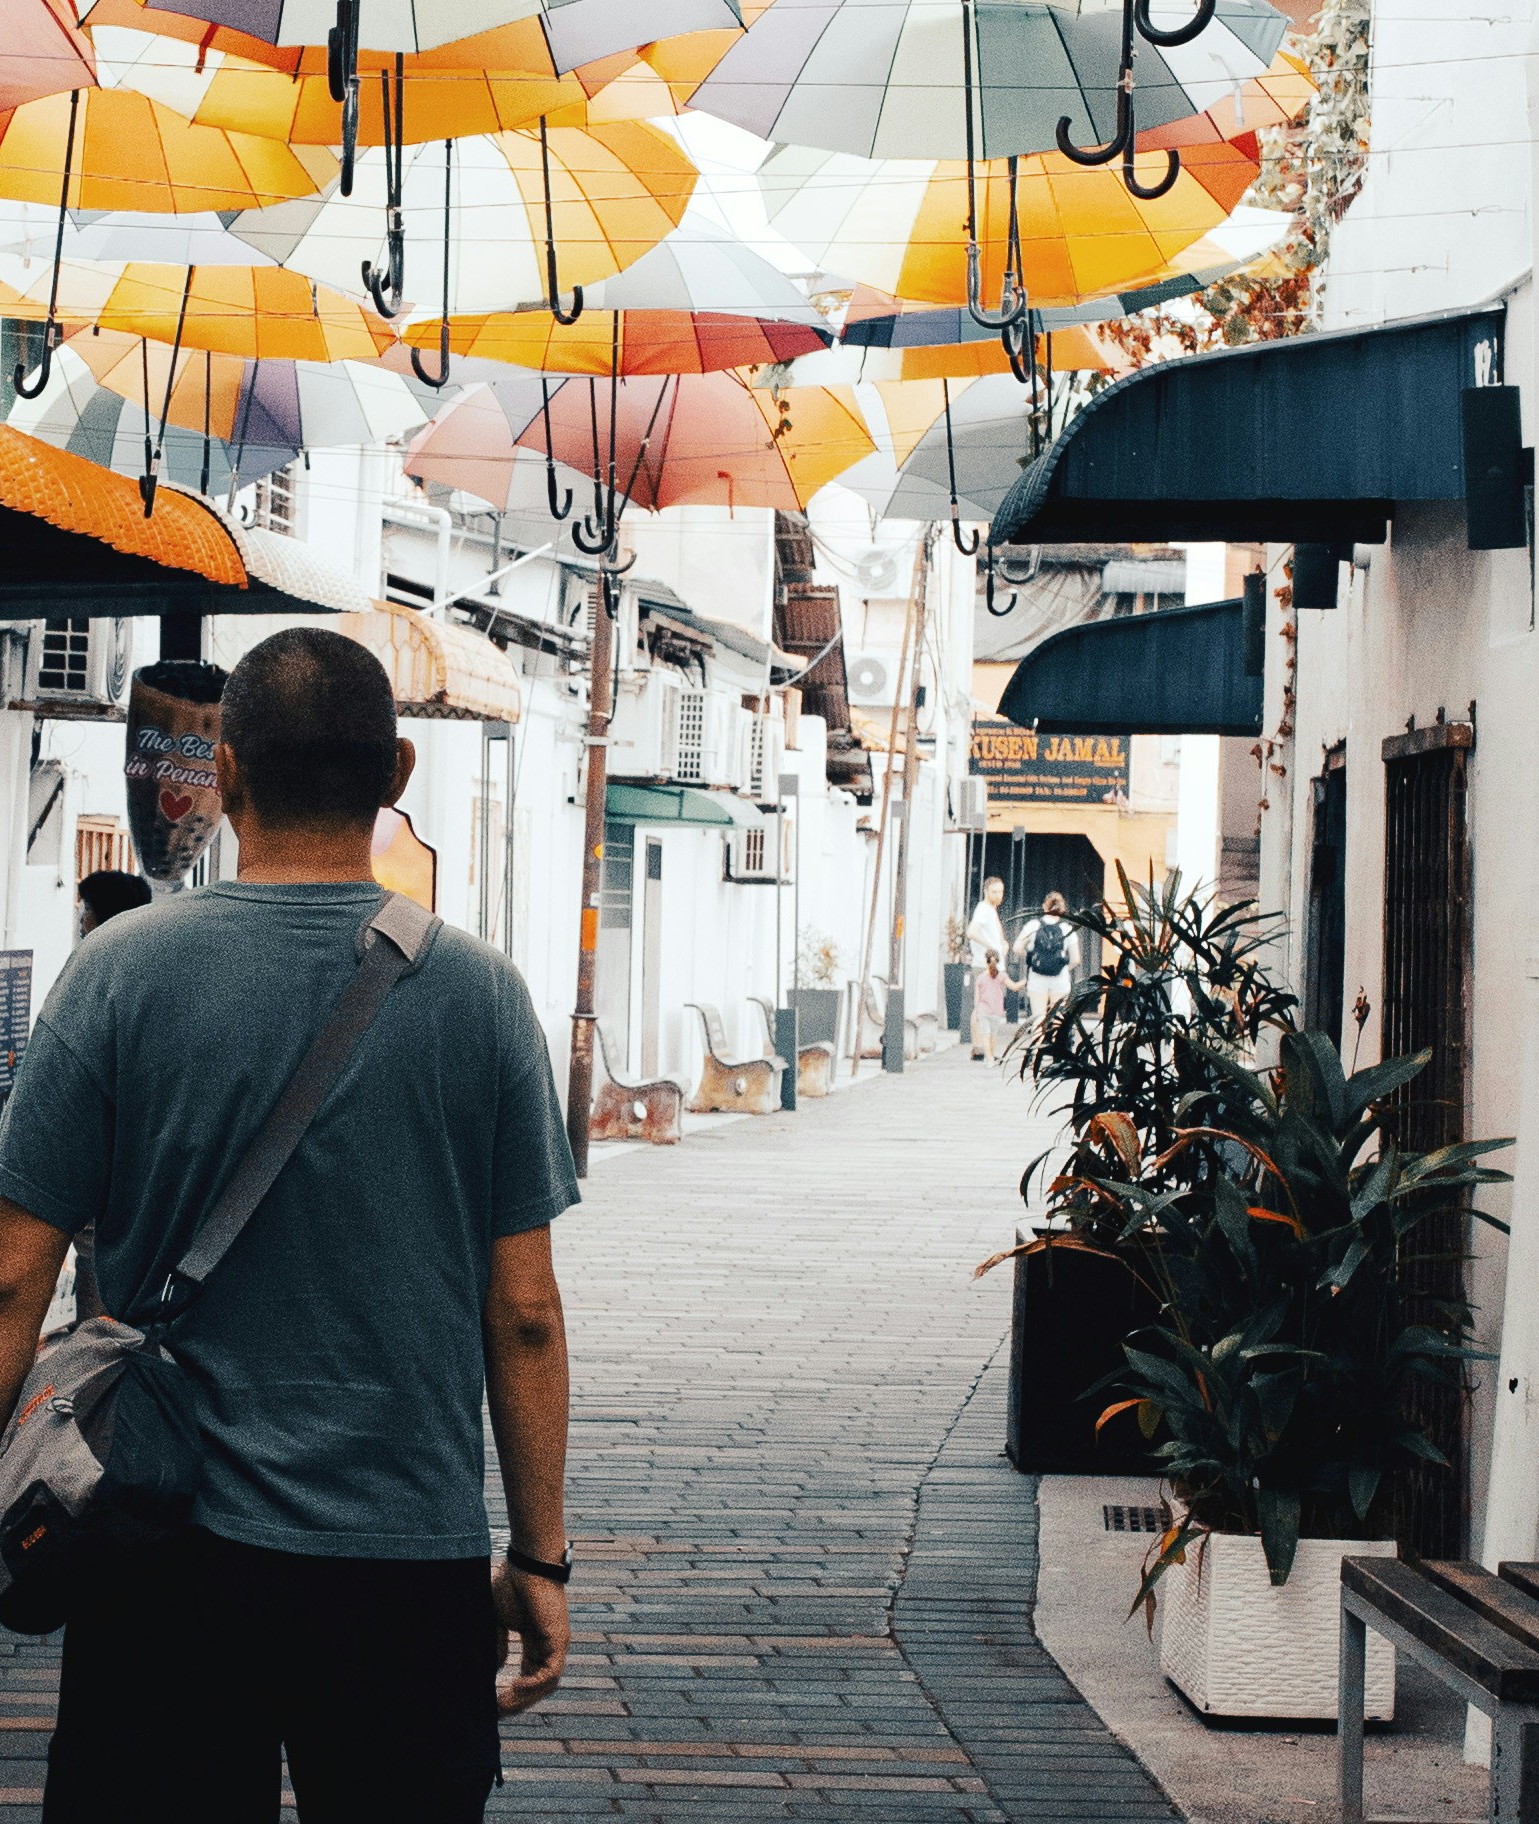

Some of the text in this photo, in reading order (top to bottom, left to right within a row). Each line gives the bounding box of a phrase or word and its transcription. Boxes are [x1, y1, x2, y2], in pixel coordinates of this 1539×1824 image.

[138, 728, 216, 760] The Bes
[1044, 736, 1126, 763] JAMAL
[125, 755, 220, 789] in Penan
